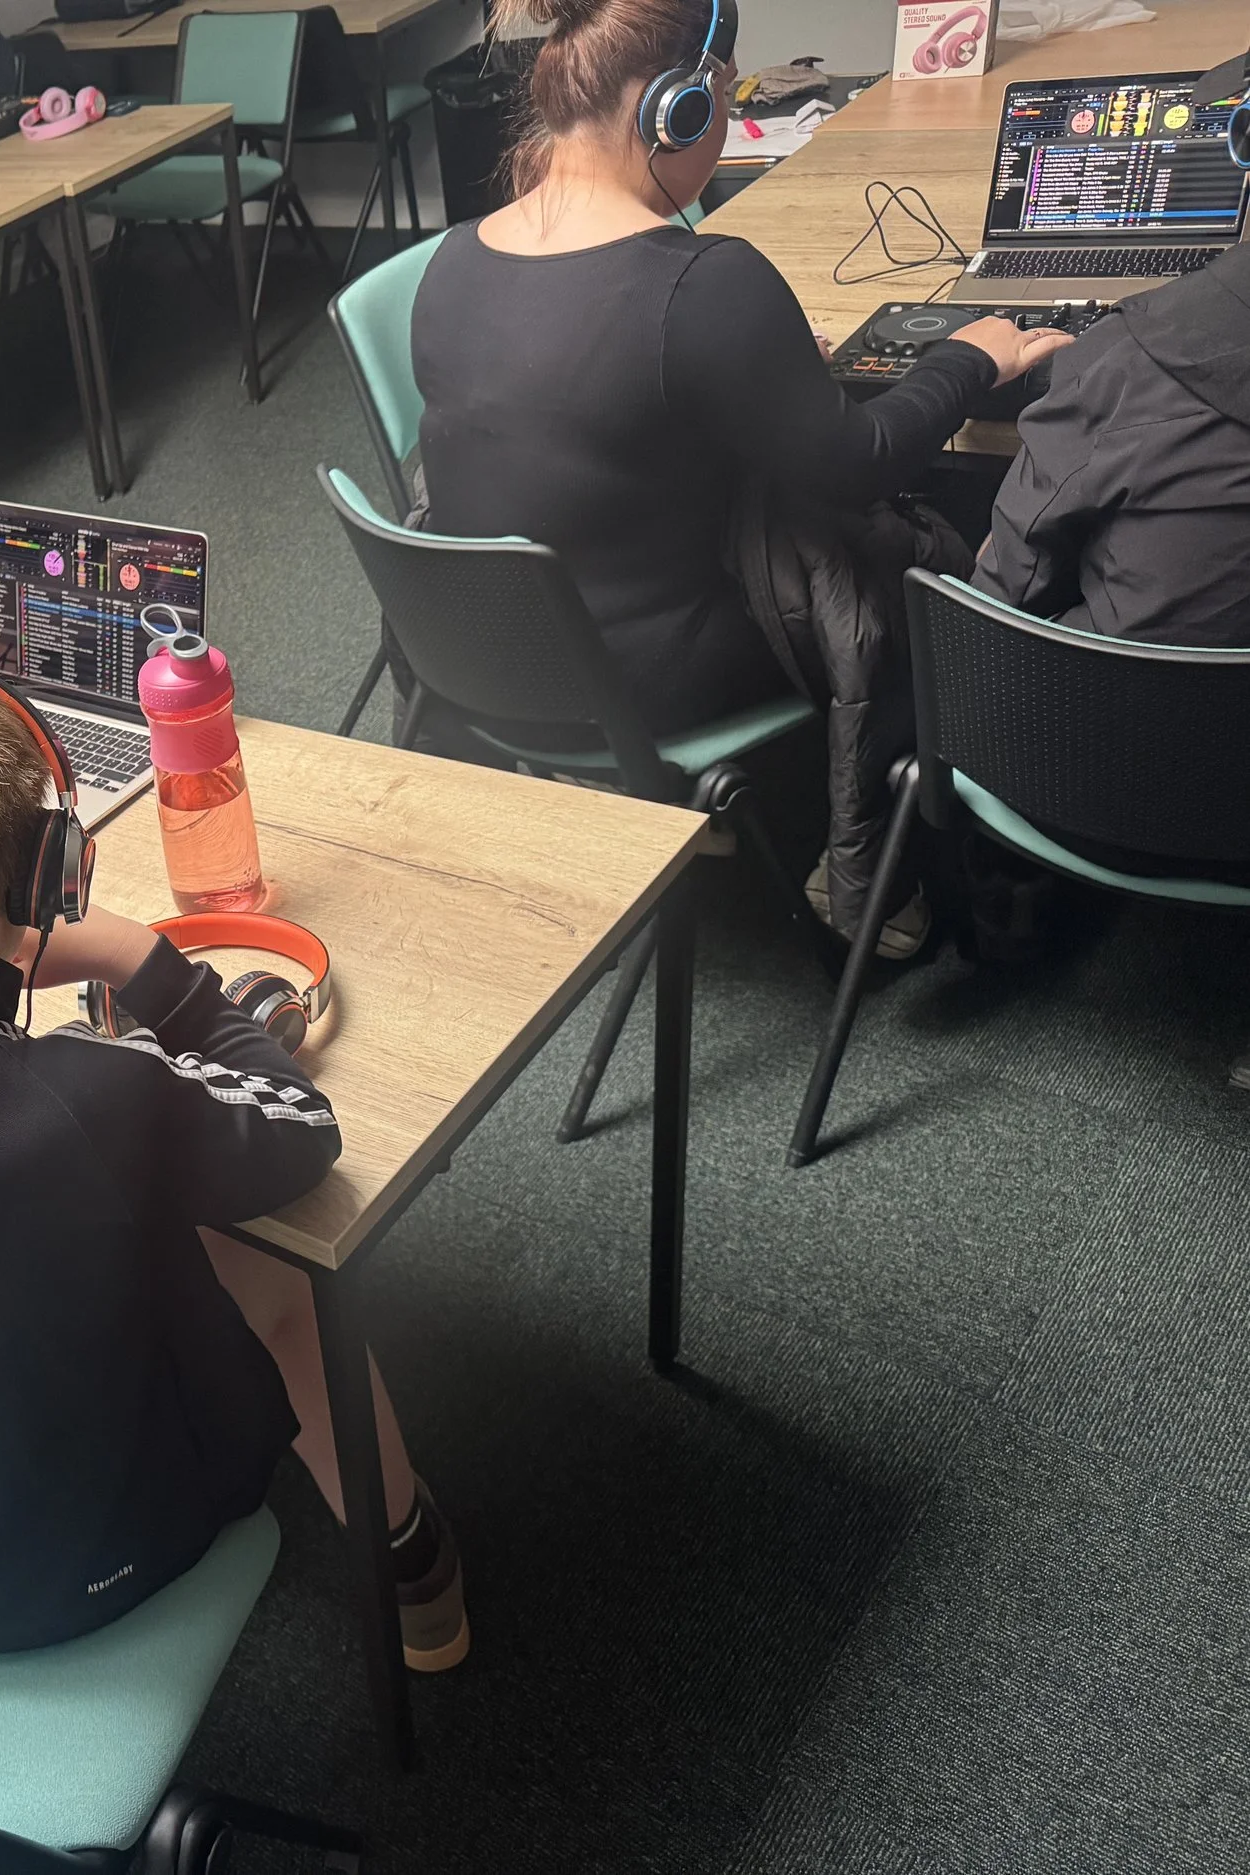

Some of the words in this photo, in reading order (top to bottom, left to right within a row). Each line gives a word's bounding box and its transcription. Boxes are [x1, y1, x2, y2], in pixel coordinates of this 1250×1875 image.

[904, 7, 929, 16] QUALITY
[903, 15, 926, 24] STEREO
[926, 14, 947, 22] SOUND
